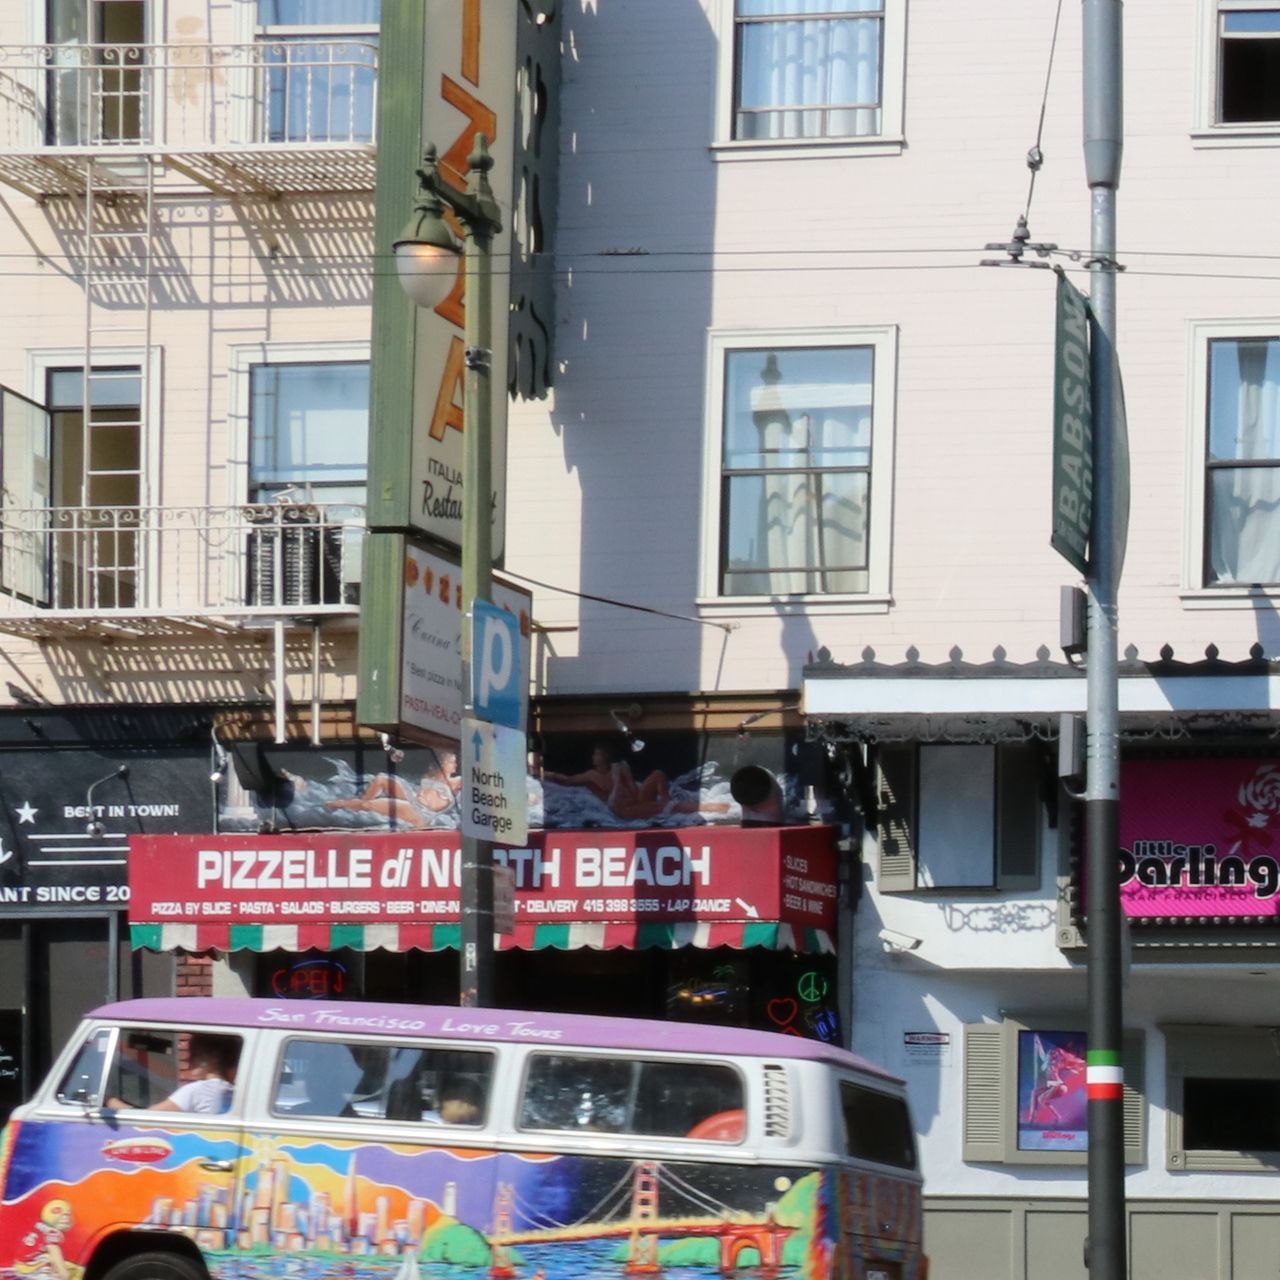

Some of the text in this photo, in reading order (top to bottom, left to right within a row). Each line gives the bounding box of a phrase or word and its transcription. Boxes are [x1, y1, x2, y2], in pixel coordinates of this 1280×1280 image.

[1058, 281, 1086, 527] BABSON
[428, 457, 464, 488] ITALIA
[472, 766, 505, 789] North
[472, 786, 507, 810] Beach
[108, 806, 125, 817] IN
[128, 804, 180, 817] TOWN!
[471, 808, 513, 834] Garage
[1133, 840, 1188, 857] little
[197, 846, 711, 890] PIZZELLE di NTH BEACH
[786, 855, 808, 874] SLICES
[37, 886, 101, 902] SINCE
[106, 885, 131, 901] 20
[151, 902, 182, 915] PIZZA
[185, 902, 200, 915] BY
[202, 902, 231, 915] SLICE
[240, 901, 275, 915] PASTA
[281, 901, 324, 914] SALADS
[330, 901, 380, 914] BURGERS
[386, 901, 415, 914] BEER
[421, 901, 460, 914] DINE-IN
[526, 900, 578, 913] DELIVERY
[583, 899, 604, 912] 415
[606, 899, 628, 912] 398
[629, 899, 660, 912] 3555
[667, 899, 690, 912] LAP
[691, 899, 731, 912] DANCE
[257, 1007, 564, 1040] San Francisco Love Tours
